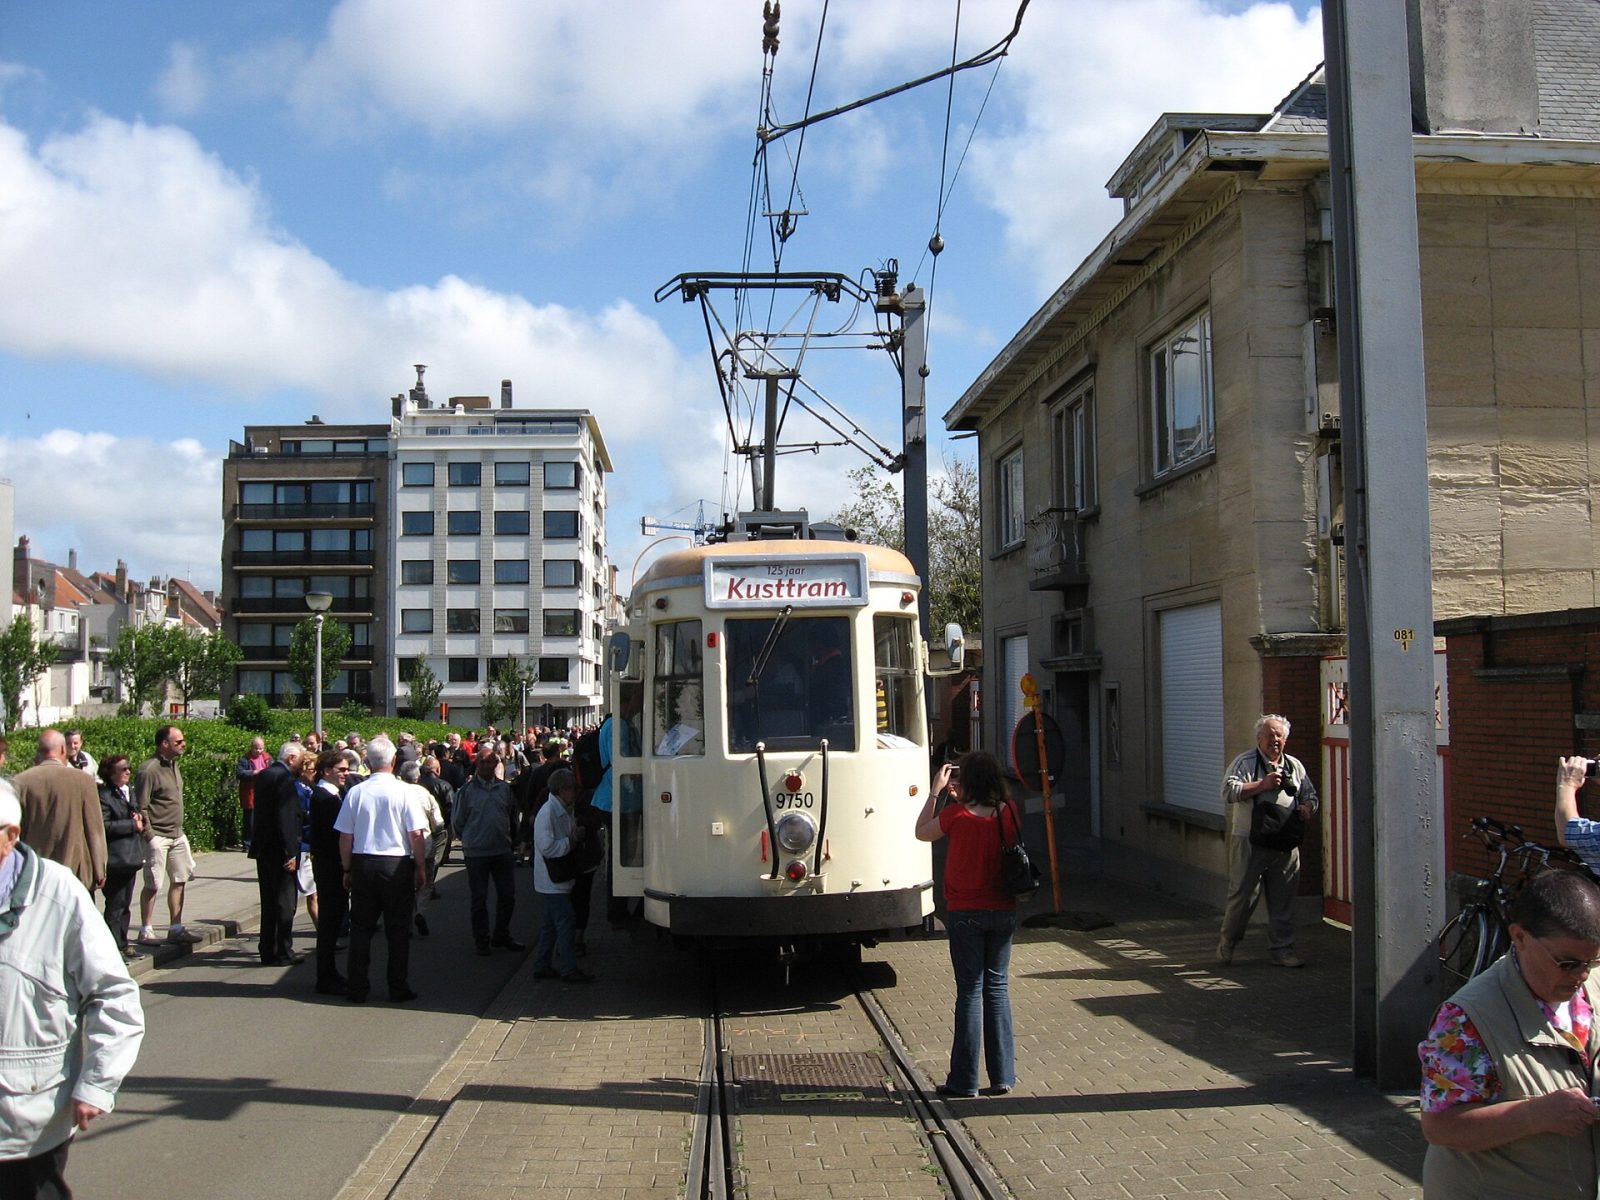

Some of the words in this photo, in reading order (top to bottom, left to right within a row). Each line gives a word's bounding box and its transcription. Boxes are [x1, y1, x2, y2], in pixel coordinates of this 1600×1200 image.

[767, 565, 783, 575] 125
[785, 566, 806, 576] jaar
[727, 577, 847, 600] Kusttram
[1394, 629, 1413, 640] 081
[1401, 640, 1407, 651] 1
[776, 792, 814, 809] 9750
